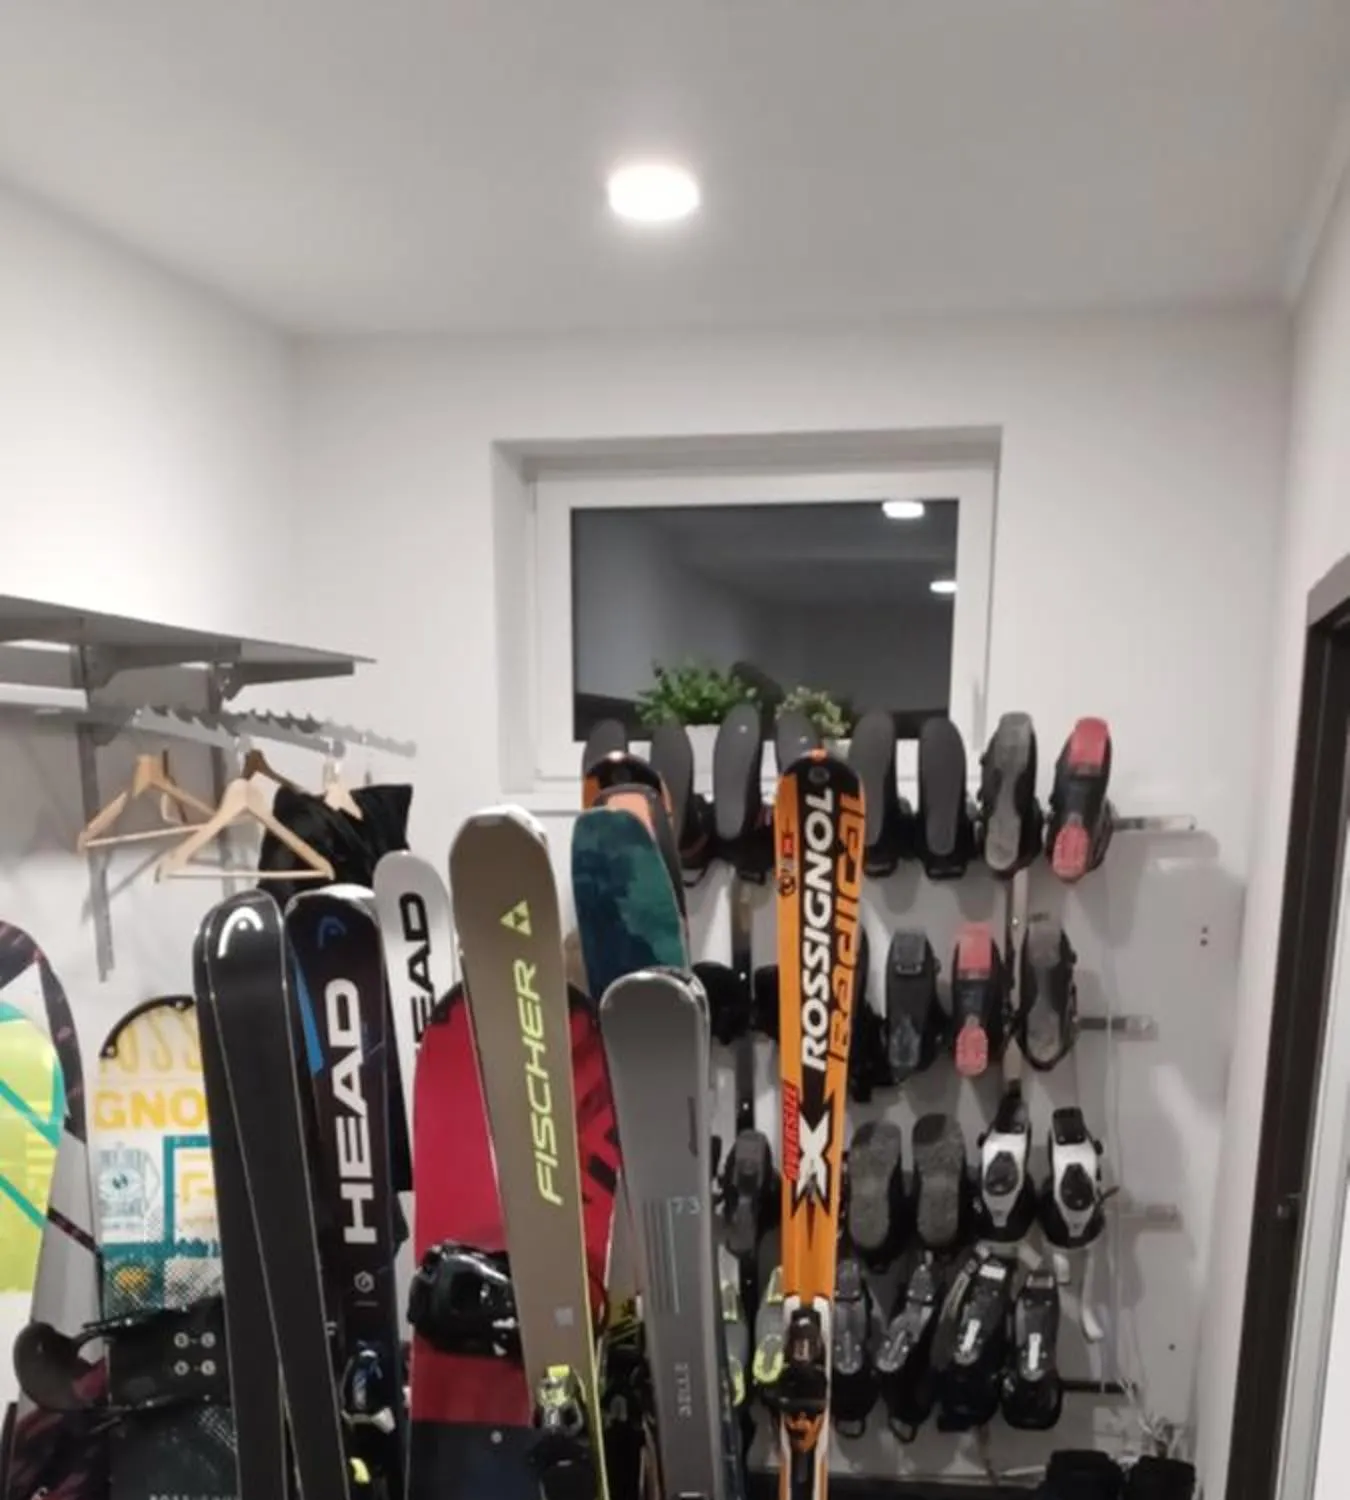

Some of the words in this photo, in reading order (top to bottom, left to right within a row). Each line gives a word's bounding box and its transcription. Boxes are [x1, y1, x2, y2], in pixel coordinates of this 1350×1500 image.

[400, 893, 435, 1053] EAD
[801, 787, 835, 1072] ROSSIGNOL
[95, 1088, 206, 1130] GNO
[325, 977, 378, 1244] HEAD
[513, 959, 562, 1206] FISCHER
